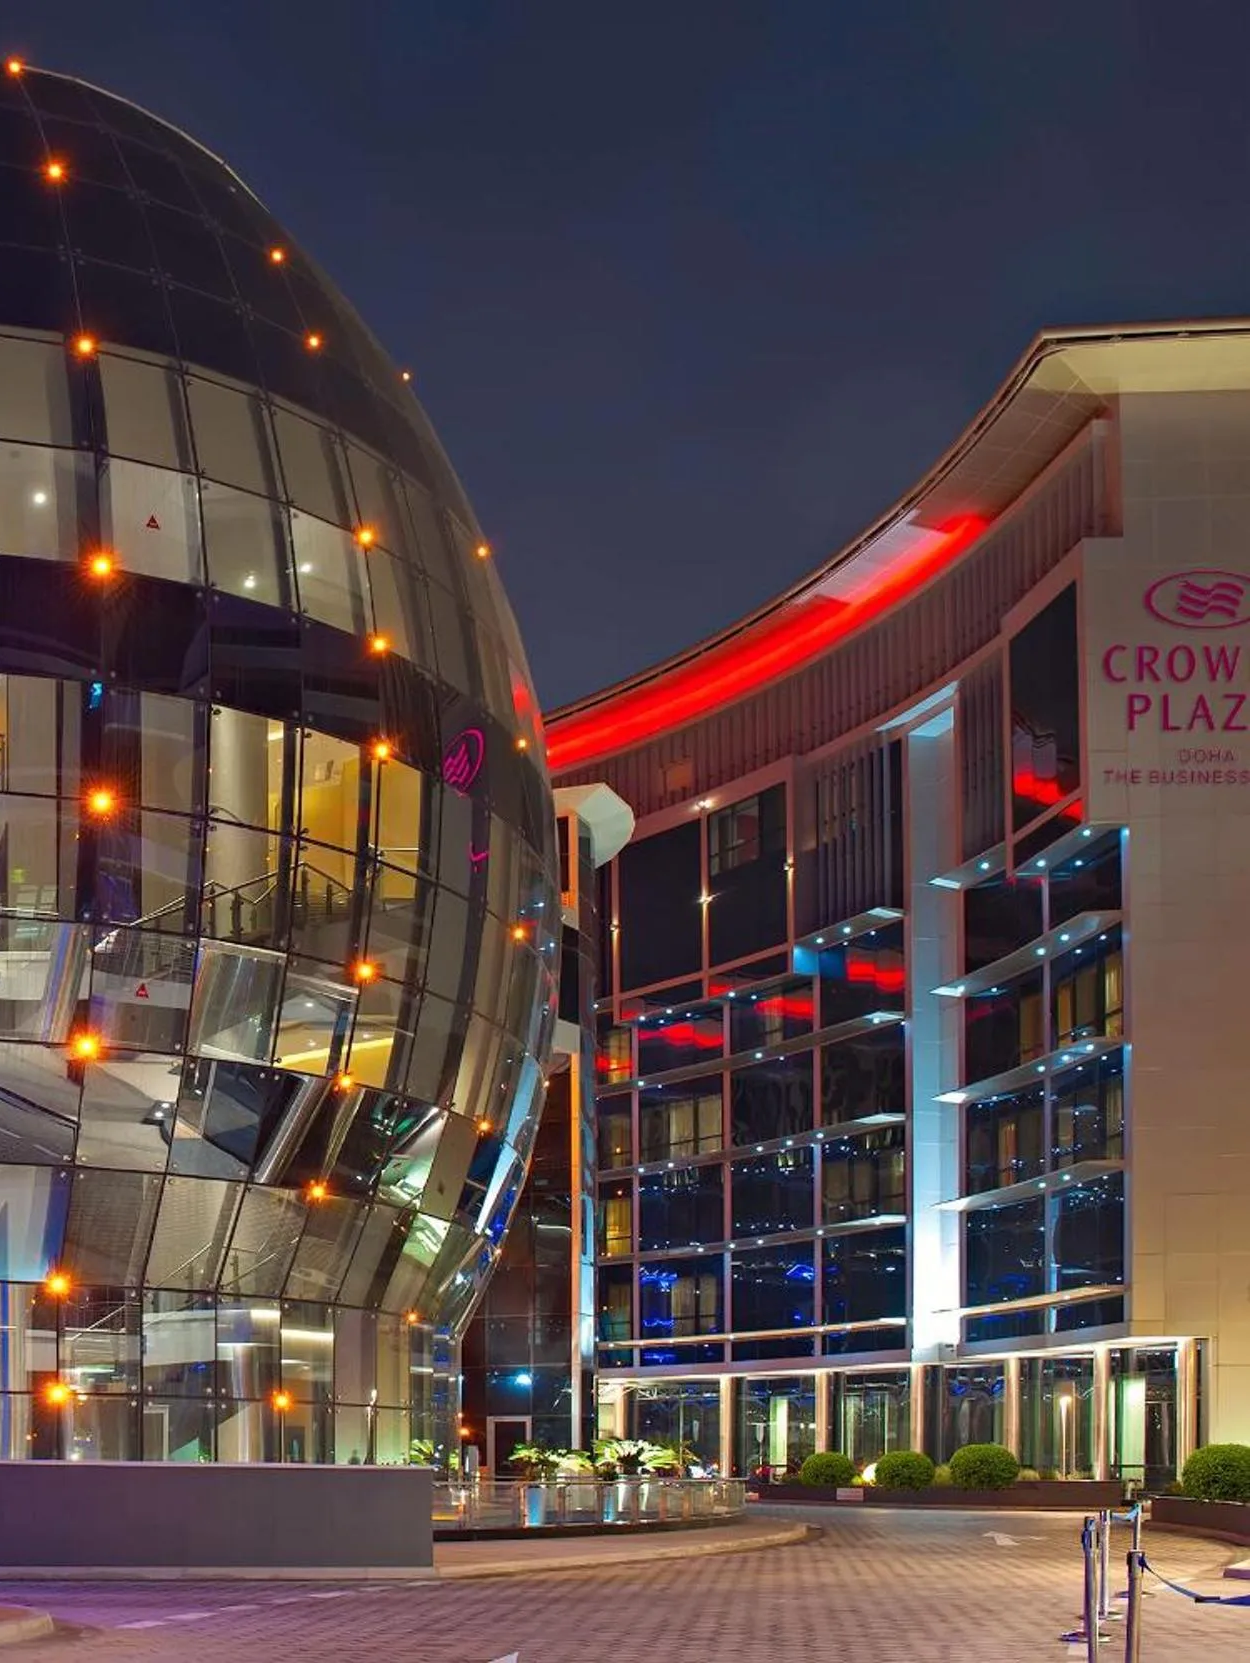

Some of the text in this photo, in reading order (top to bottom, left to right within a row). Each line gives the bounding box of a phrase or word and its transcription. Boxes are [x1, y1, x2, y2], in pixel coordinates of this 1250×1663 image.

[1103, 645, 1250, 682] CROW
[1127, 694, 1247, 731] PLAZ
[1179, 749, 1235, 764] DOHA
[1103, 770, 1250, 785] THE BUSINESS
